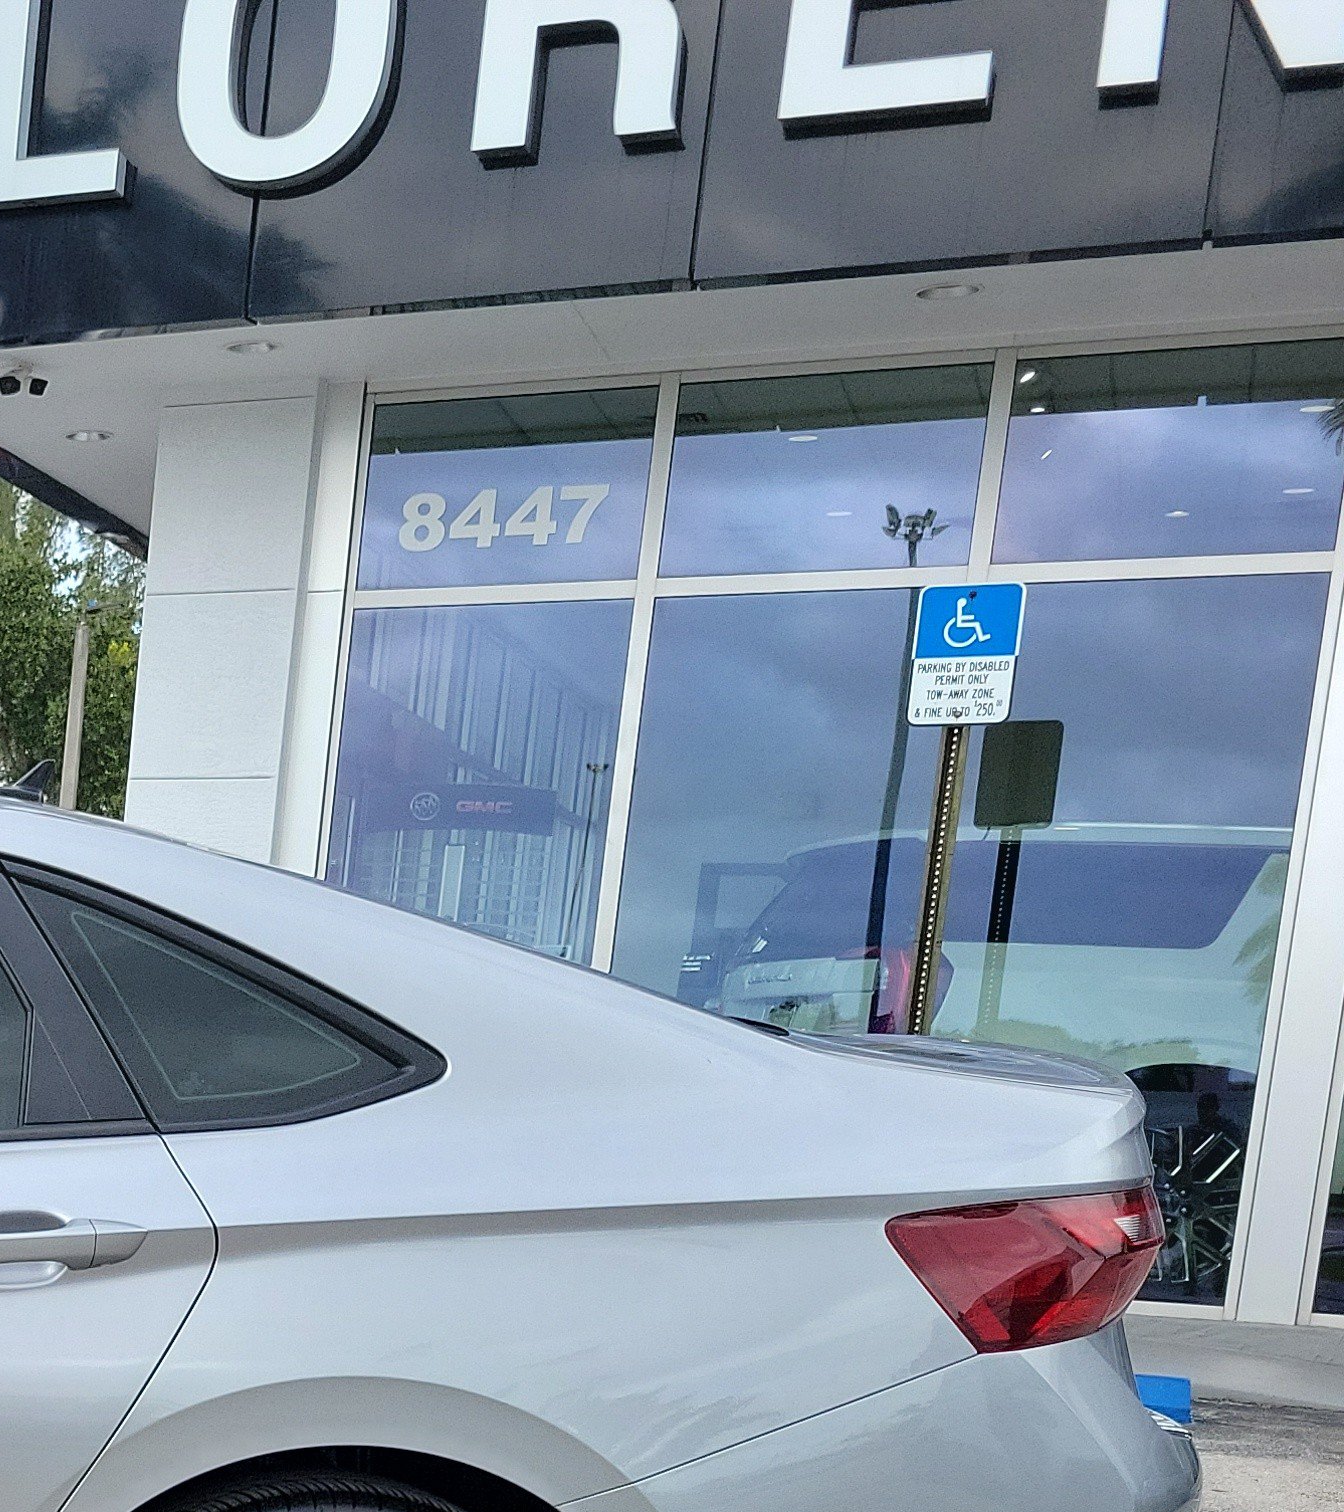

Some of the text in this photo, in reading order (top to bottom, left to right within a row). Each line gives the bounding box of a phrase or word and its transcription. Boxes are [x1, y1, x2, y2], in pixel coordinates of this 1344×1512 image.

[398, 484, 611, 552] 8447
[917, 661, 1010, 674] PARKING BY DISABLED
[934, 673, 990, 685] PERMIT ONLY
[926, 688, 995, 700] TOW-AWAY ZONE
[924, 707, 943, 718] FINE
[945, 706, 958, 717] UP
[960, 706, 971, 717] TO
[455, 800, 512, 814] GMC
